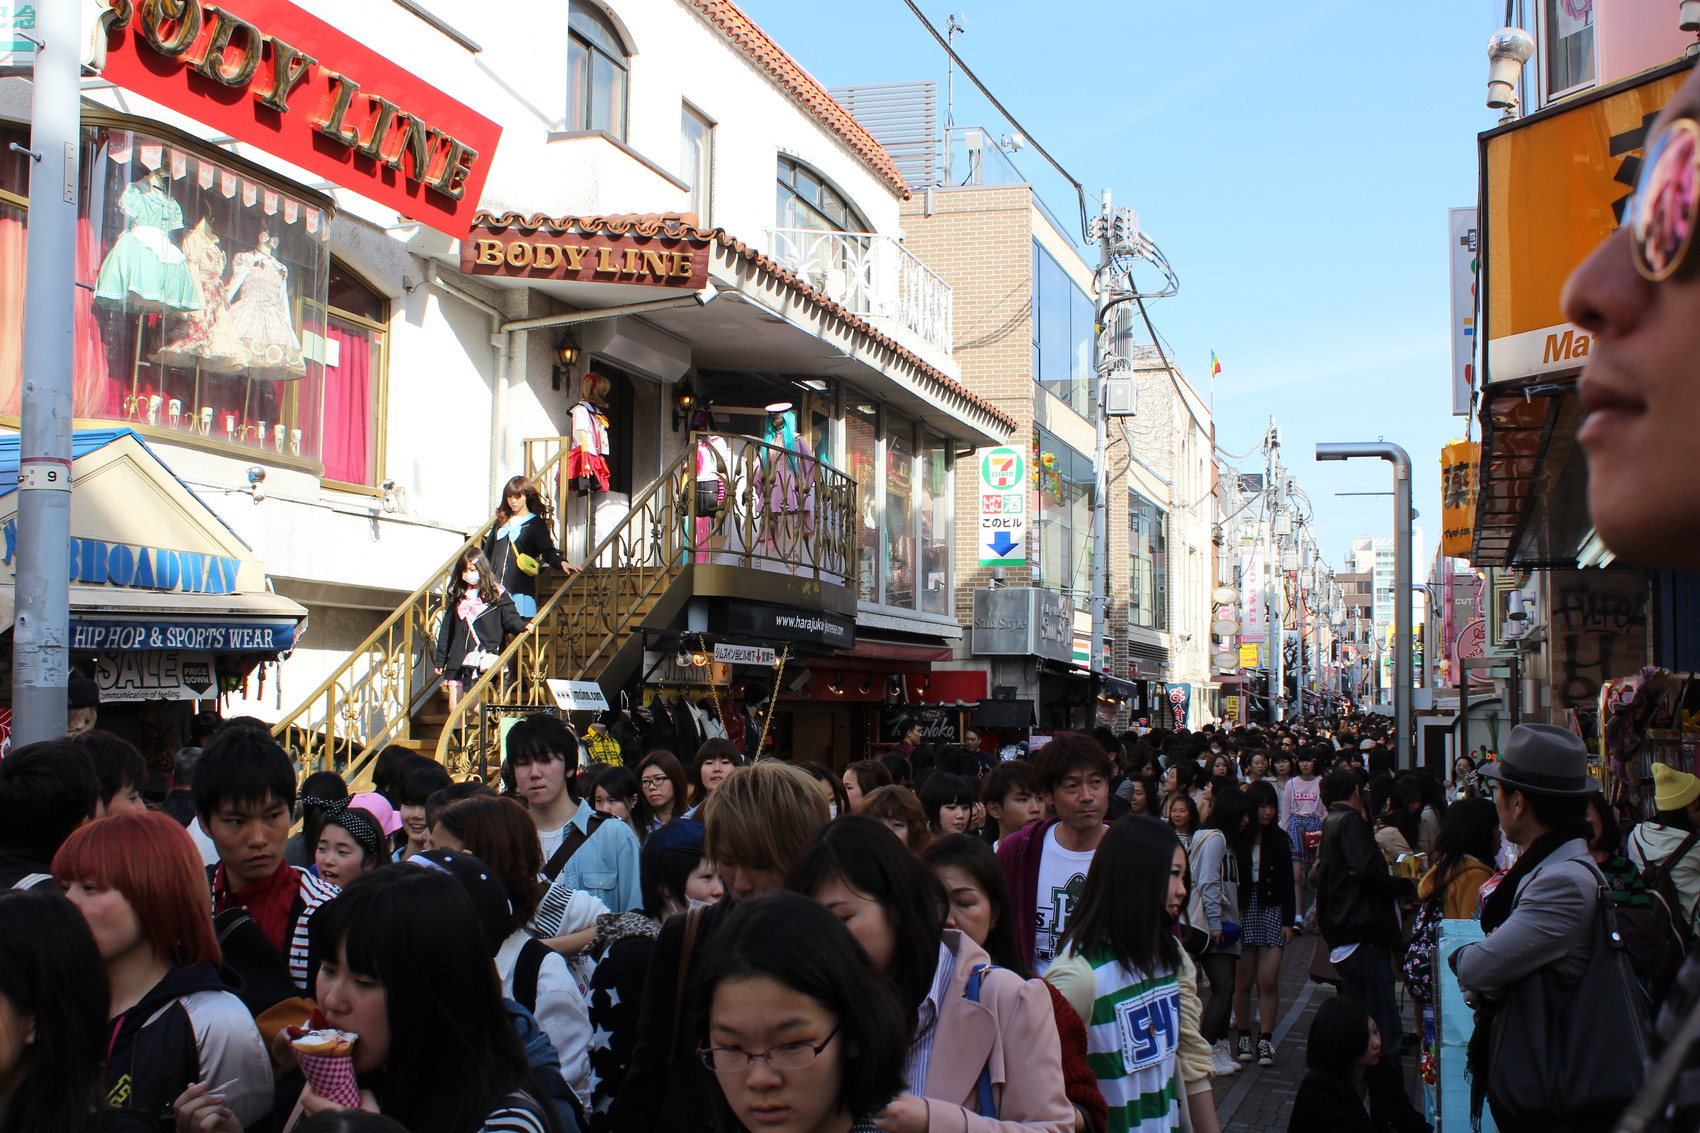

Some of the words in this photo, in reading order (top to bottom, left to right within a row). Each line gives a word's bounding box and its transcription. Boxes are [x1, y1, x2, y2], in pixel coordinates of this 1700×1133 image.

[318, 73, 479, 201] LINE
[476, 239, 589, 270] BODY
[596, 247, 694, 278] LINE
[1543, 329, 1594, 364] Ma
[47, 470, 57, 482] 9
[983, 496, 1002, 513] たばこ
[1004, 496, 1022, 513] 酒
[982, 518, 1022, 528] このビル
[1249, 561, 1257, 583] NO
[1249, 589, 1257, 626] FALL
[974, 618, 997, 629] Sun
[998, 617, 1027, 631] Style
[74, 626, 103, 648] HIP
[104, 626, 146, 648] HOP
[150, 628, 164, 648] &
[166, 626, 226, 649] SPORTS
[228, 628, 275, 648] WEAR
[98, 650, 181, 690] SALE
[184, 667, 208, 676] PRICE
[185, 676, 209, 684] DOWN
[149, 690, 158, 699] of
